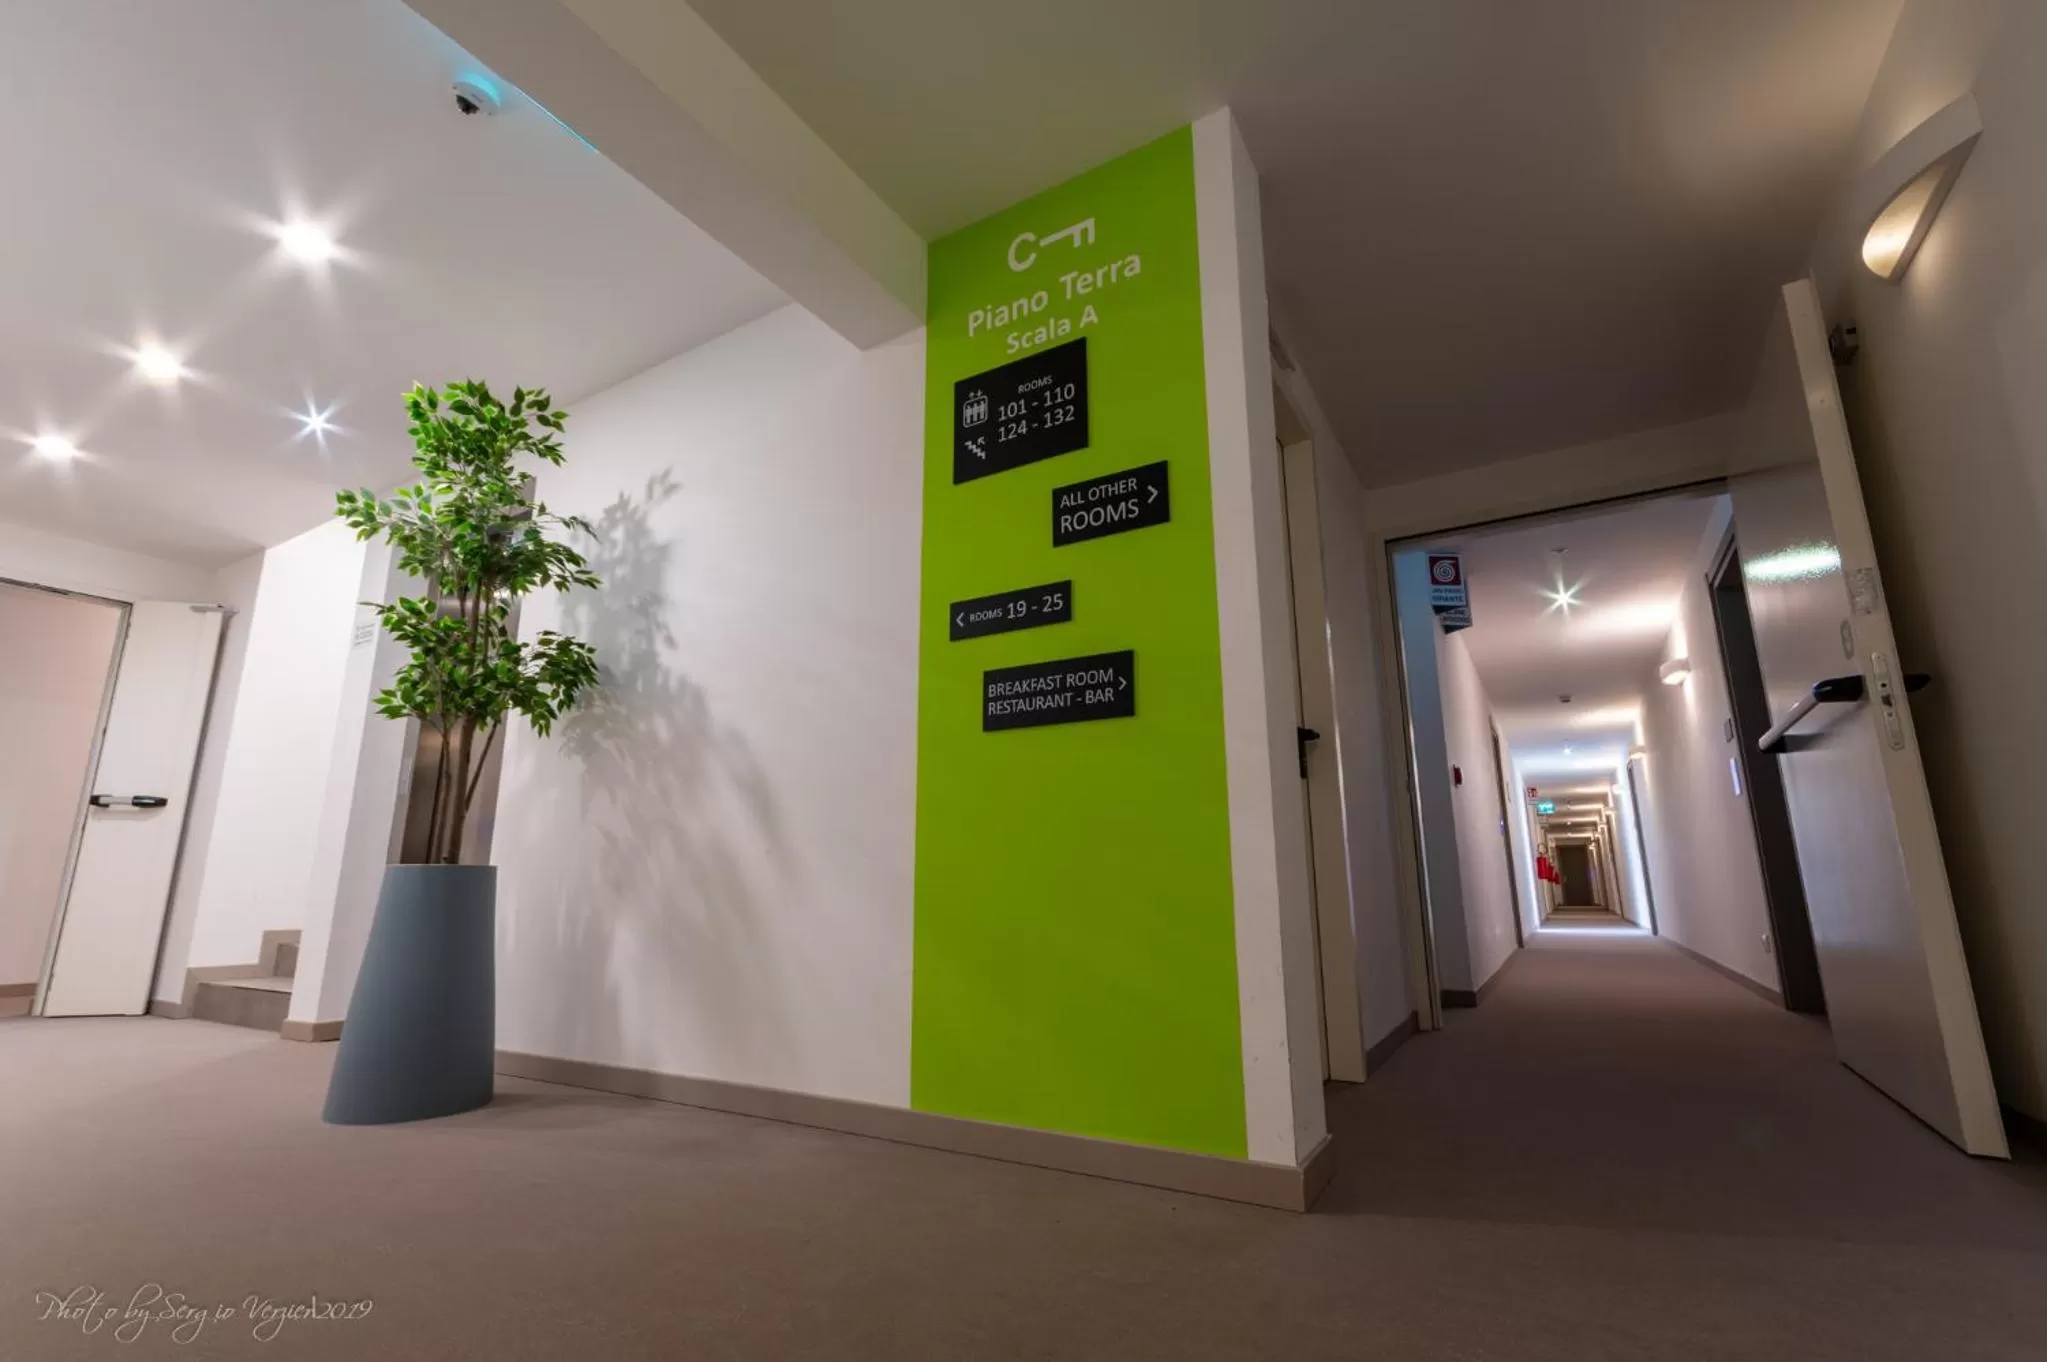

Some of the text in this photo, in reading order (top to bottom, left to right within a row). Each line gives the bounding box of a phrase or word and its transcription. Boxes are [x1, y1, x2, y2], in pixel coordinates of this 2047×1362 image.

[967, 253, 1142, 337] Piano Terra
[1006, 304, 1099, 355] Scala A
[1017, 375, 1053, 395] ROOMS
[998, 399, 1028, 422] 101
[1043, 383, 1076, 407] 110
[998, 420, 1029, 443] 124
[1043, 404, 1076, 429] 132
[1059, 477, 1139, 509] ALL OTHER
[1060, 498, 1141, 535] ROOMS
[969, 608, 1003, 623] ROOMS
[1007, 600, 1028, 620] 19
[1042, 593, 1064, 614] 25
[988, 667, 1115, 698] BREAKFAST ROOM
[988, 692, 1074, 716] RESTAURANT
[1085, 686, 1115, 706] BAR
